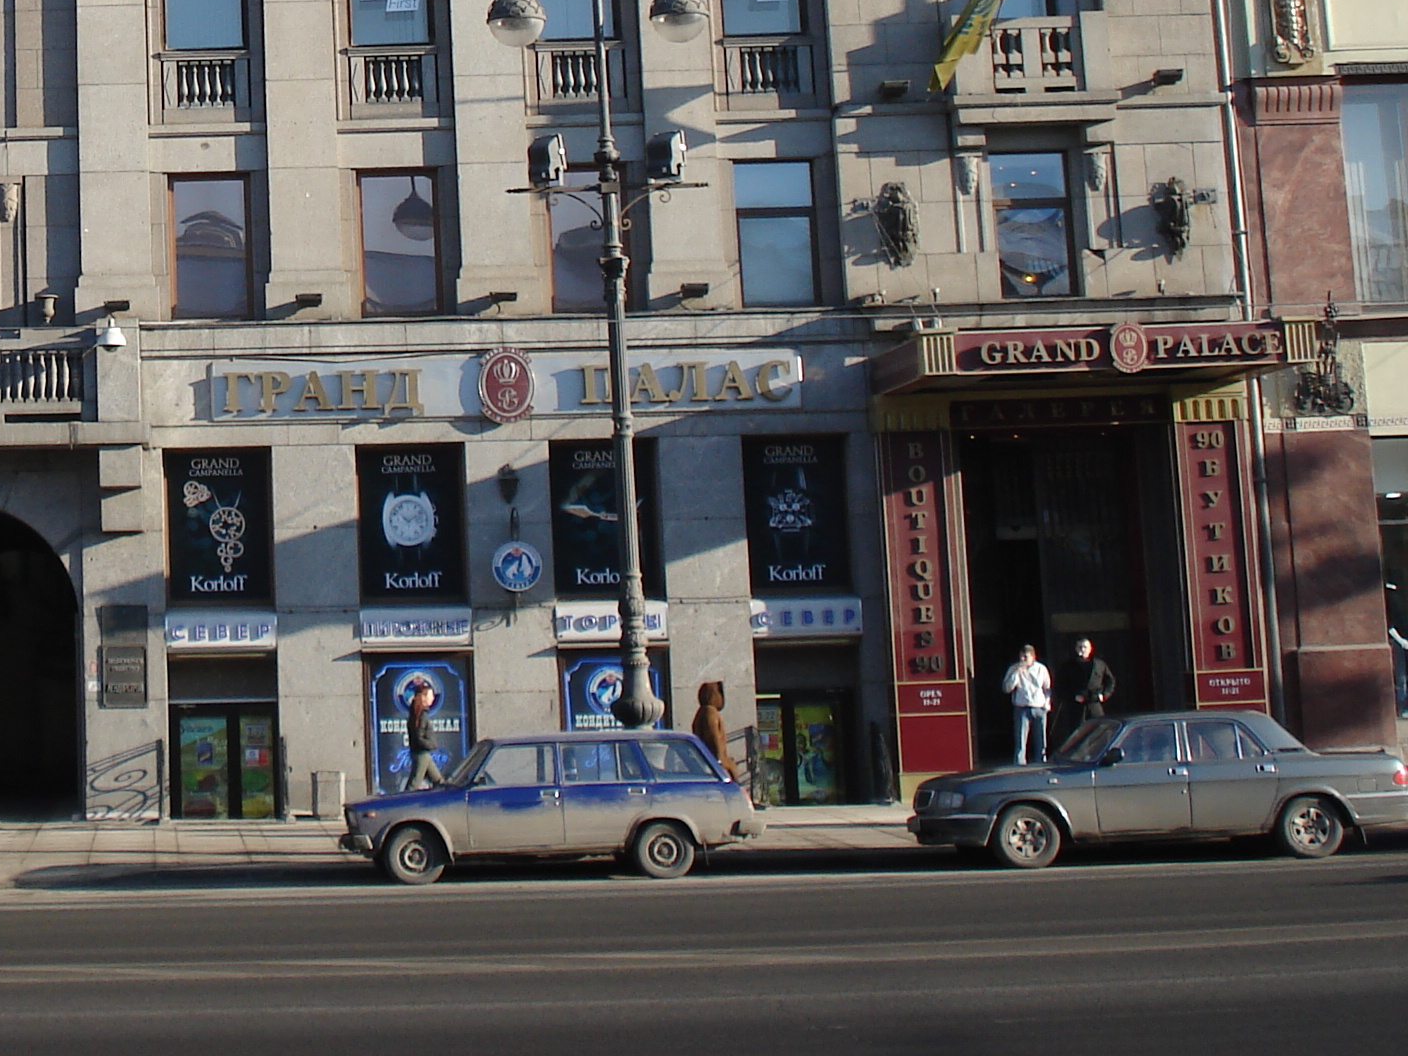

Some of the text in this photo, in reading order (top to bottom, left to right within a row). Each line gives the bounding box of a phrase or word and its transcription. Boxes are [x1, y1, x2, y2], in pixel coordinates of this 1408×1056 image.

[980, 330, 1284, 365] GRAND PALACE
[223, 360, 793, 417] ГРАНД ПАЛАС
[574, 450, 613, 462] GRAN
[765, 445, 814, 457] GRAND
[191, 458, 240, 470] GRAND
[383, 454, 432, 466] GRAND
[189, 469, 244, 477] CAMPANELLA
[381, 465, 436, 474] CAMPANELLA
[1196, 430, 1237, 659] 90 БУТИКОВ
[908, 442, 944, 673] BOUTIQUES 90
[385, 572, 442, 589] Korloff
[576, 568, 621, 585] Korlo
[768, 564, 826, 582] Korloff
[190, 575, 248, 592] Korloff
[562, 613, 661, 630] ТОРЫ
[758, 609, 855, 626] СЕВЕР
[172, 624, 271, 640] СЕВЕР
[363, 619, 469, 637] ПИРОЖНЫЕ
[379, 718, 460, 733] КОНДСКАЯ
